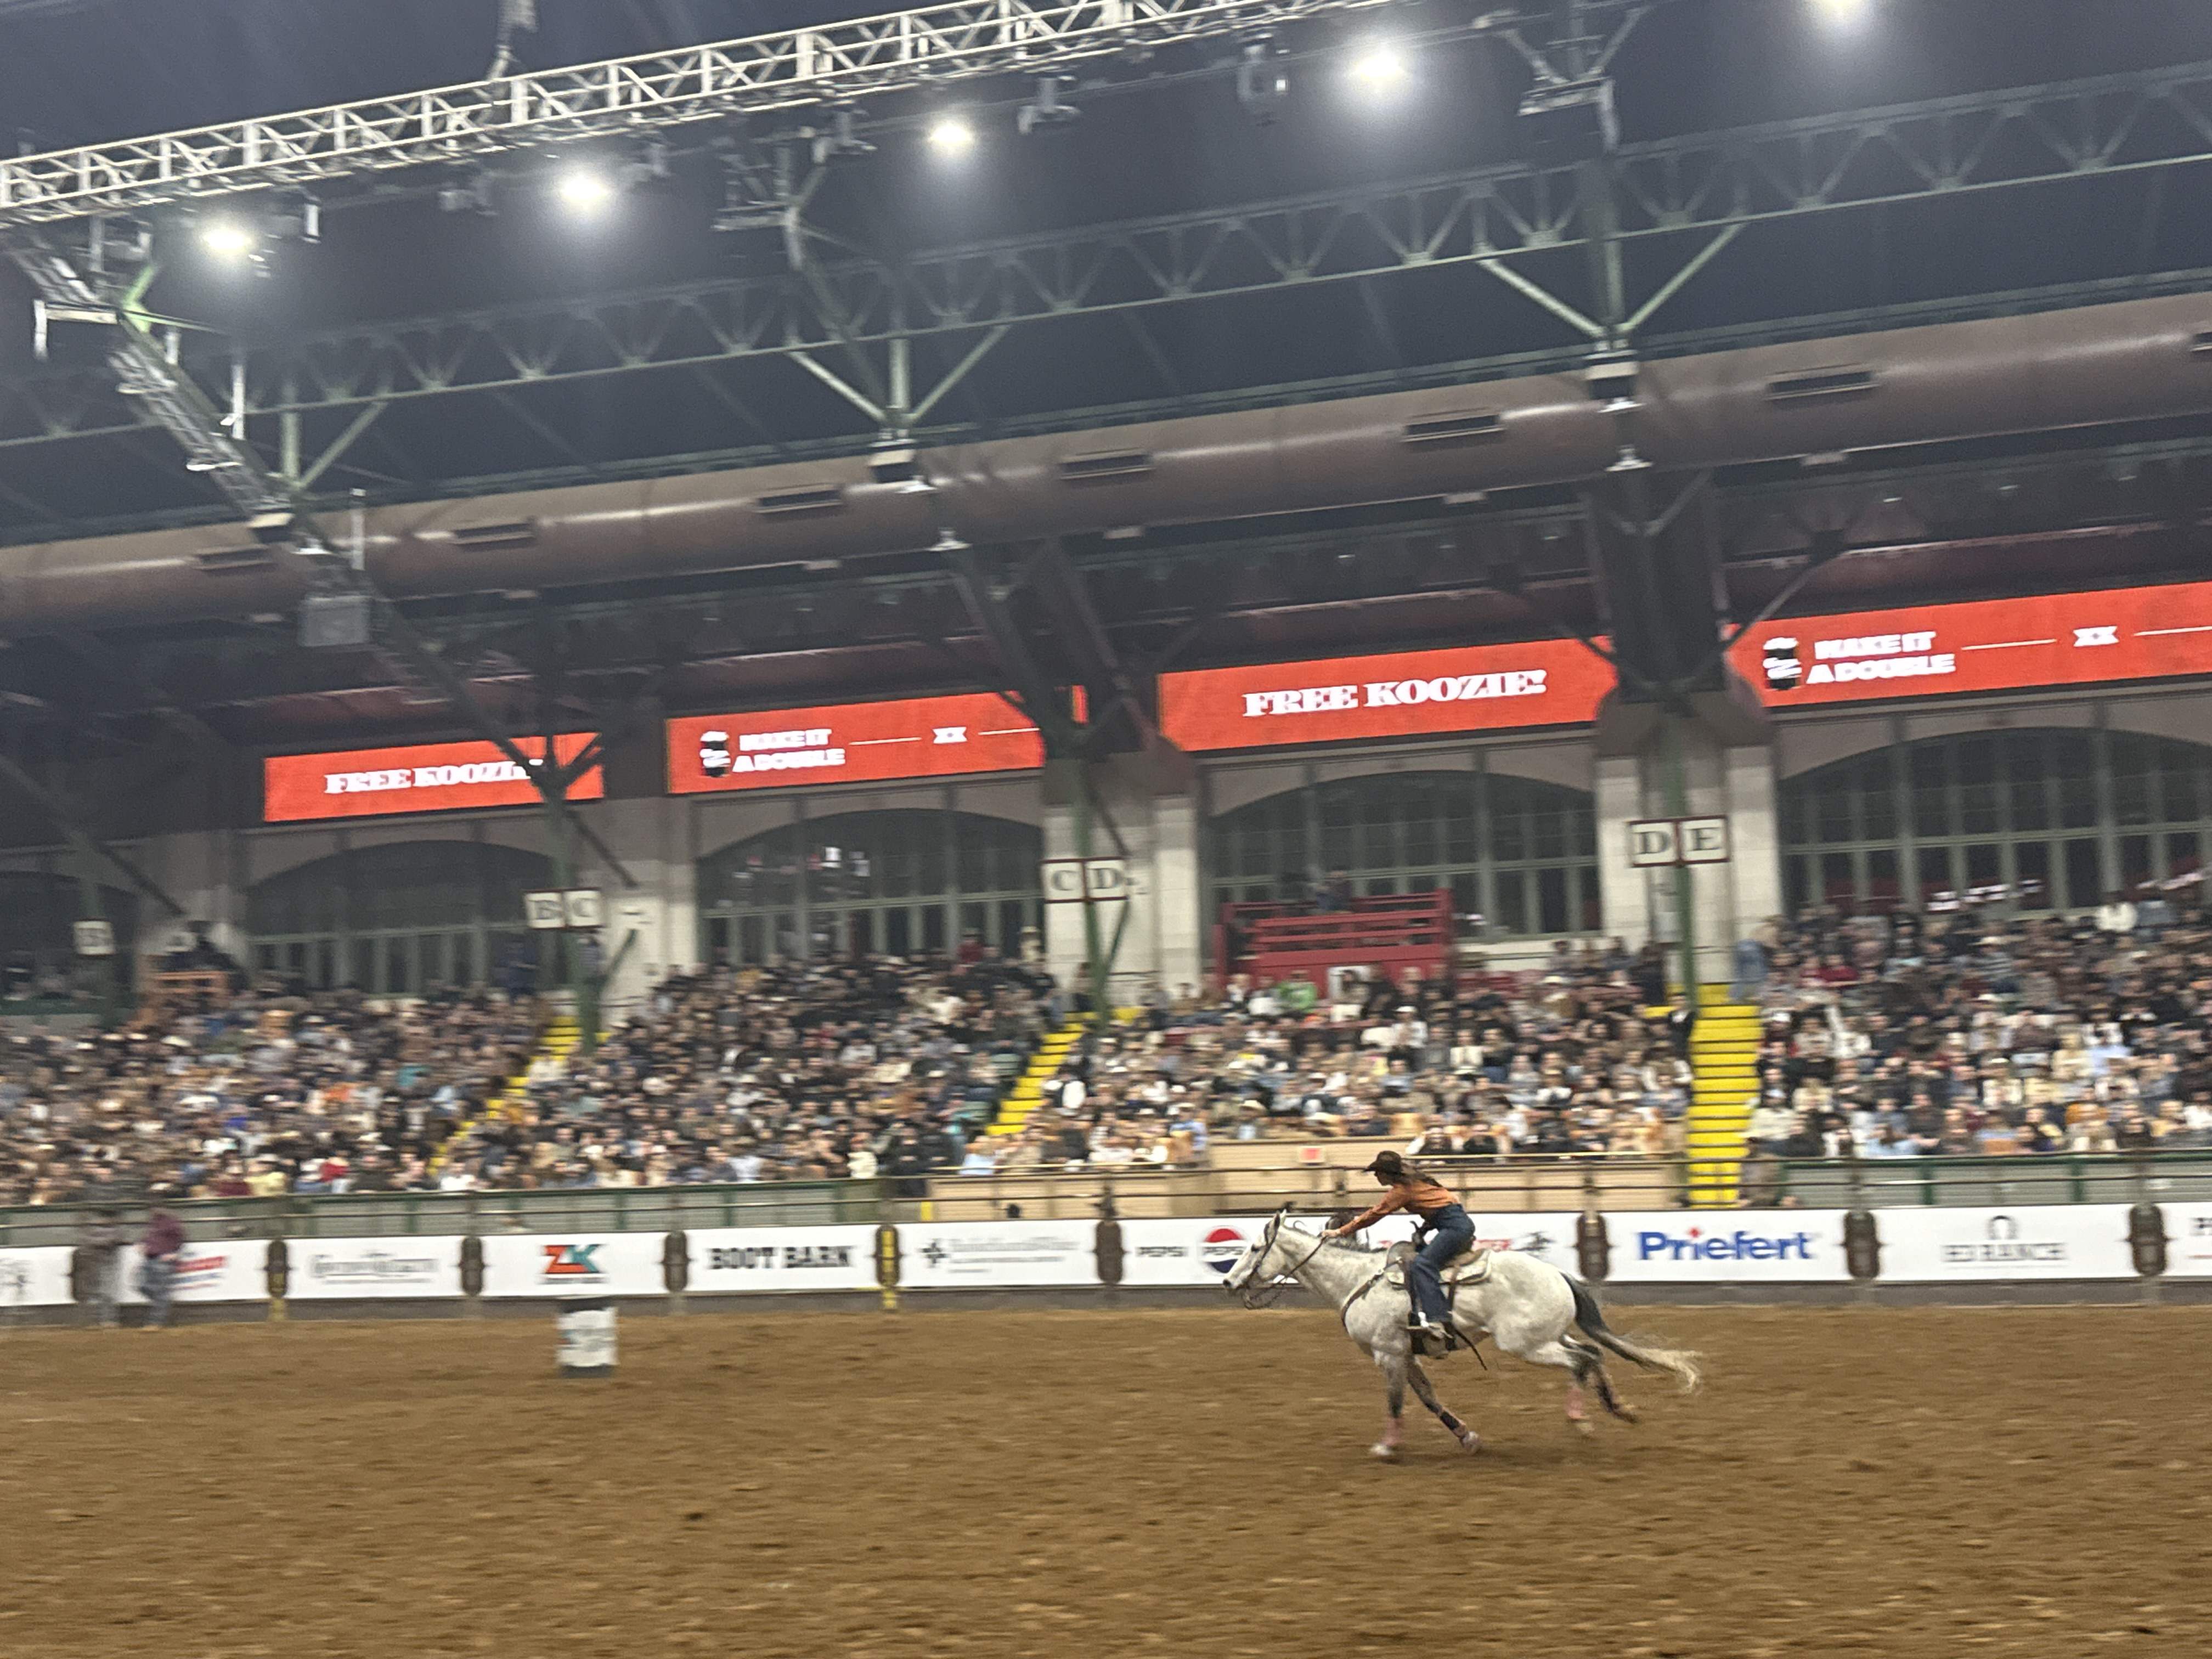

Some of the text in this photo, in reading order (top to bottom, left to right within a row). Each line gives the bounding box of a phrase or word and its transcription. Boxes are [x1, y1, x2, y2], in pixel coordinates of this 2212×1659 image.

[1902, 630, 1936, 653] IT
[1241, 685, 1358, 716] FREE
[324, 768, 411, 794] FREE
[1632, 827, 1724, 855] D E
[1051, 867, 1124, 891] C D
[1637, 1227, 1815, 1260] Priefert
[708, 1247, 776, 1269] BOOT
